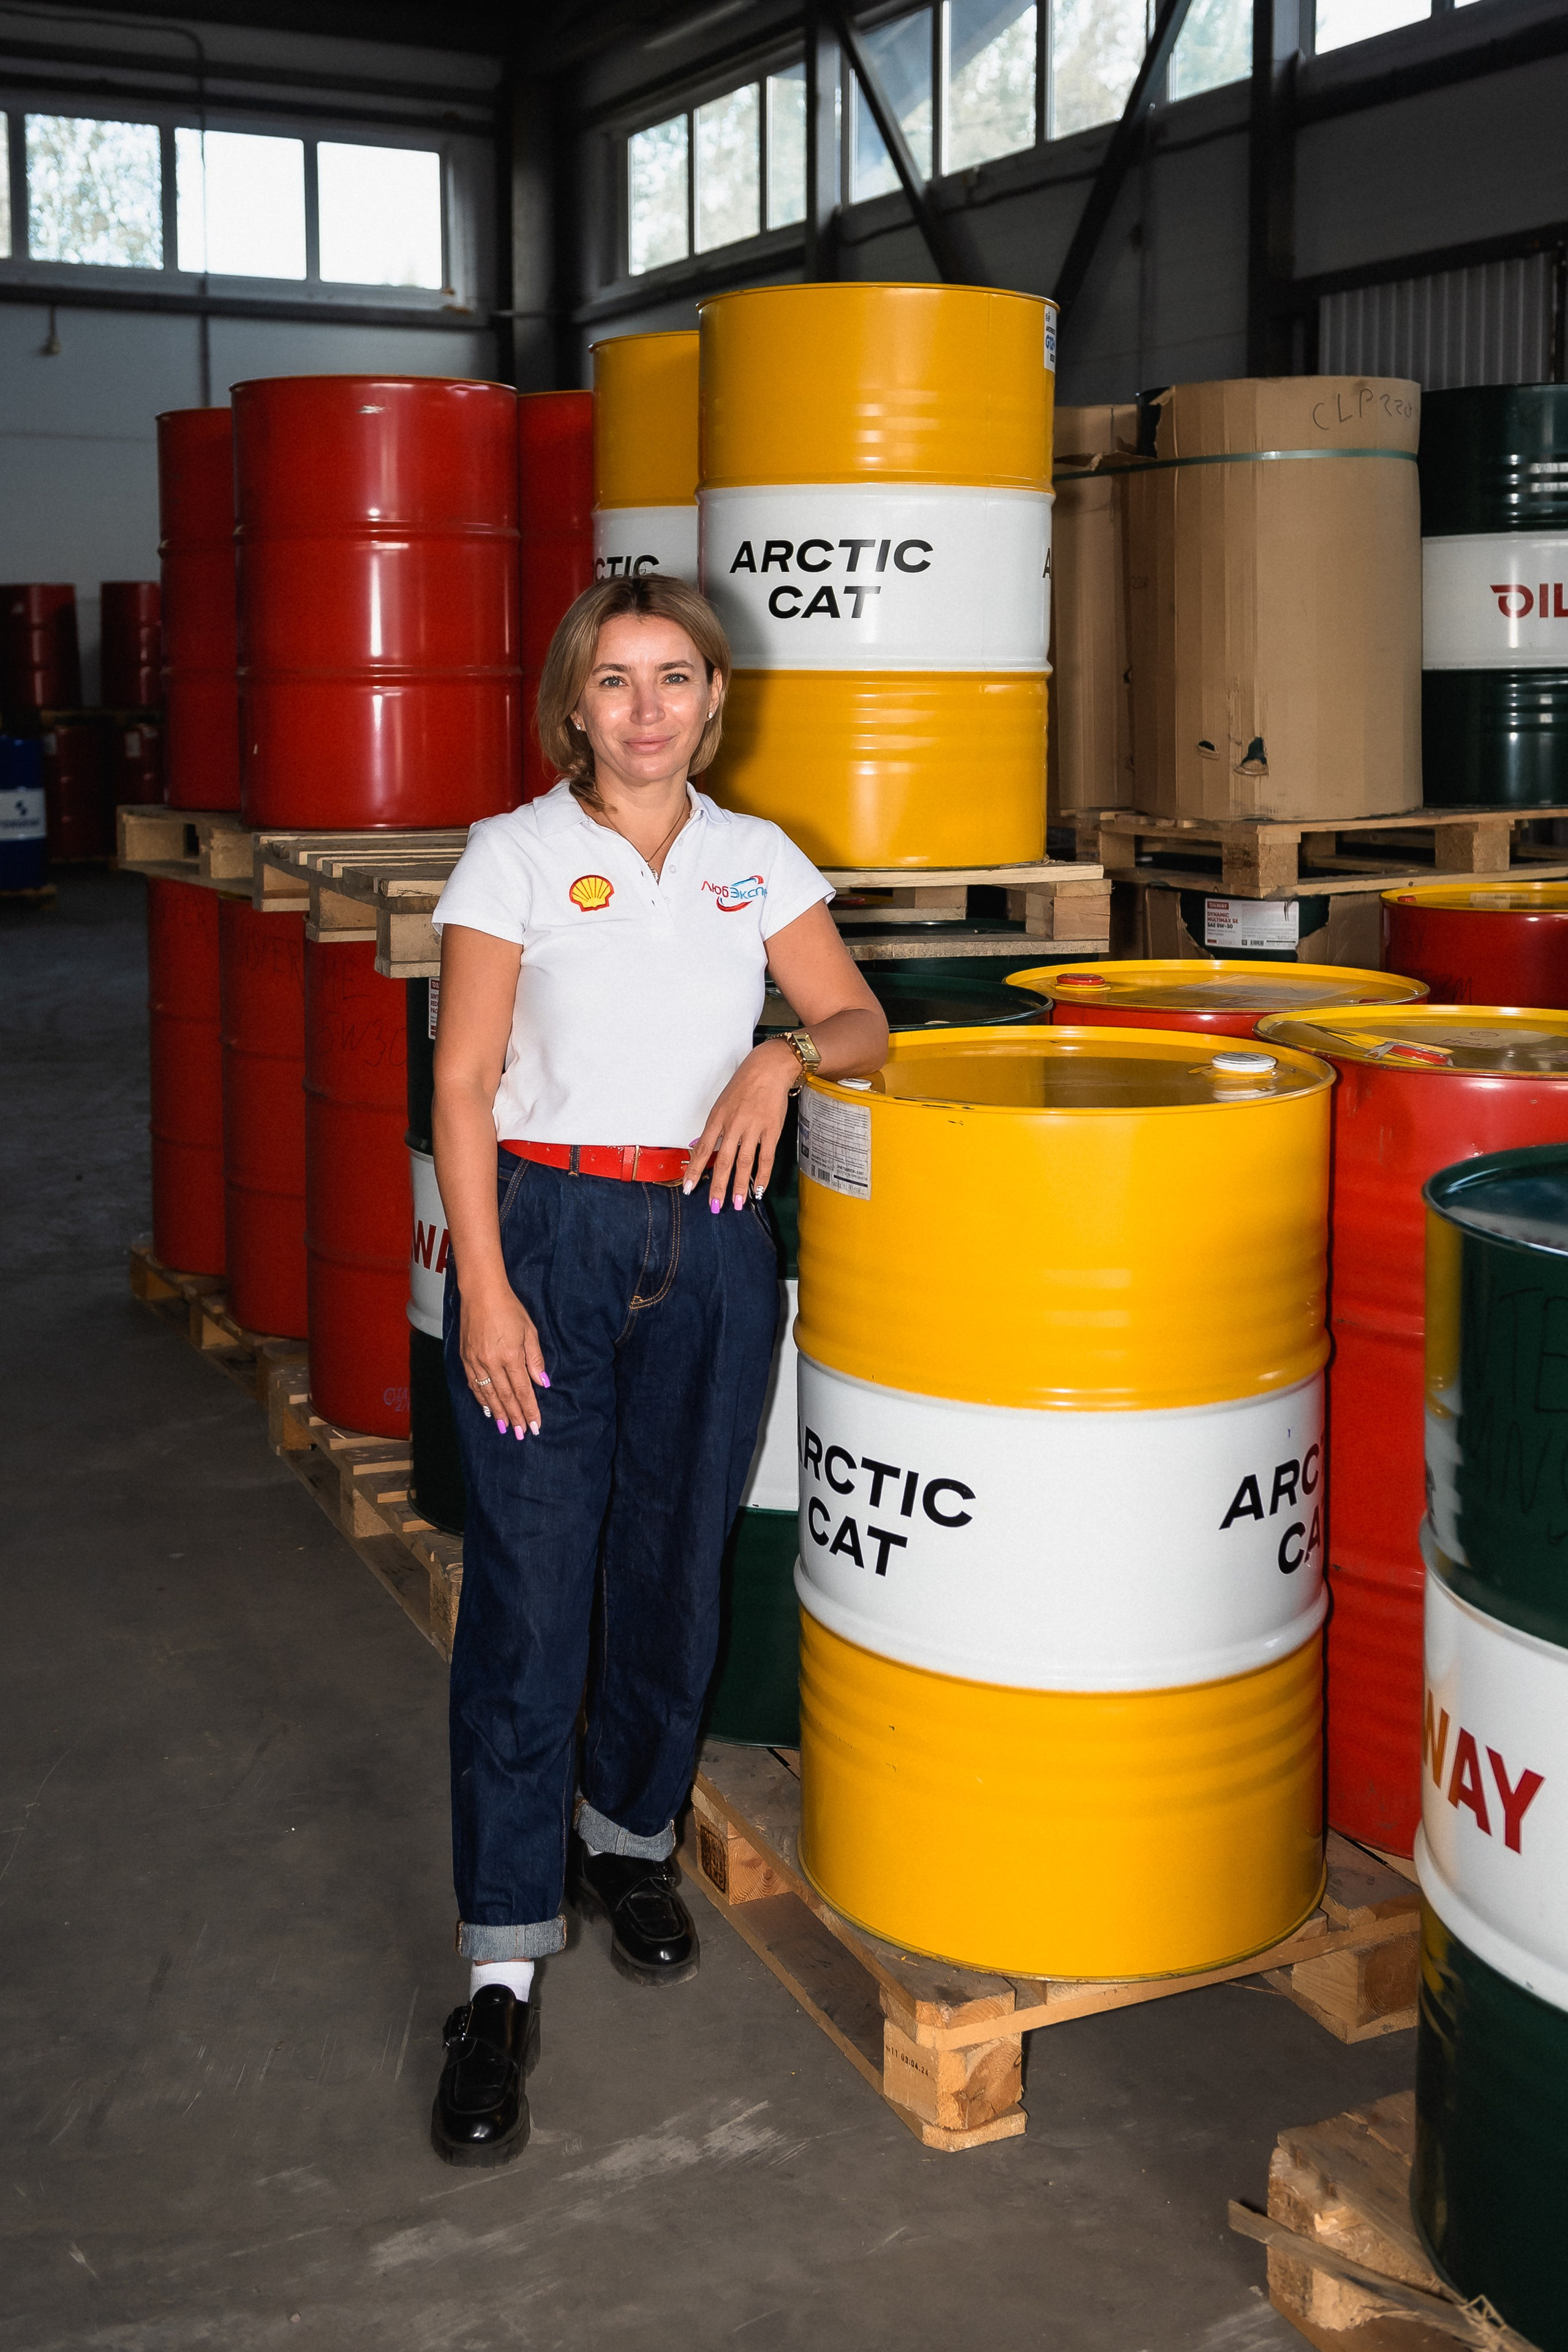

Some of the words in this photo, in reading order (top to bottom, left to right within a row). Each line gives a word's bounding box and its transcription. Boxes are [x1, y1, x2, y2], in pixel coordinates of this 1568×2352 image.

[730, 539, 933, 573] ARCTIC
[768, 585, 881, 619] CAT
[1219, 1436, 1325, 1531] ARC
[807, 1494, 908, 1577] CAT
[1277, 1504, 1324, 1576] CA
